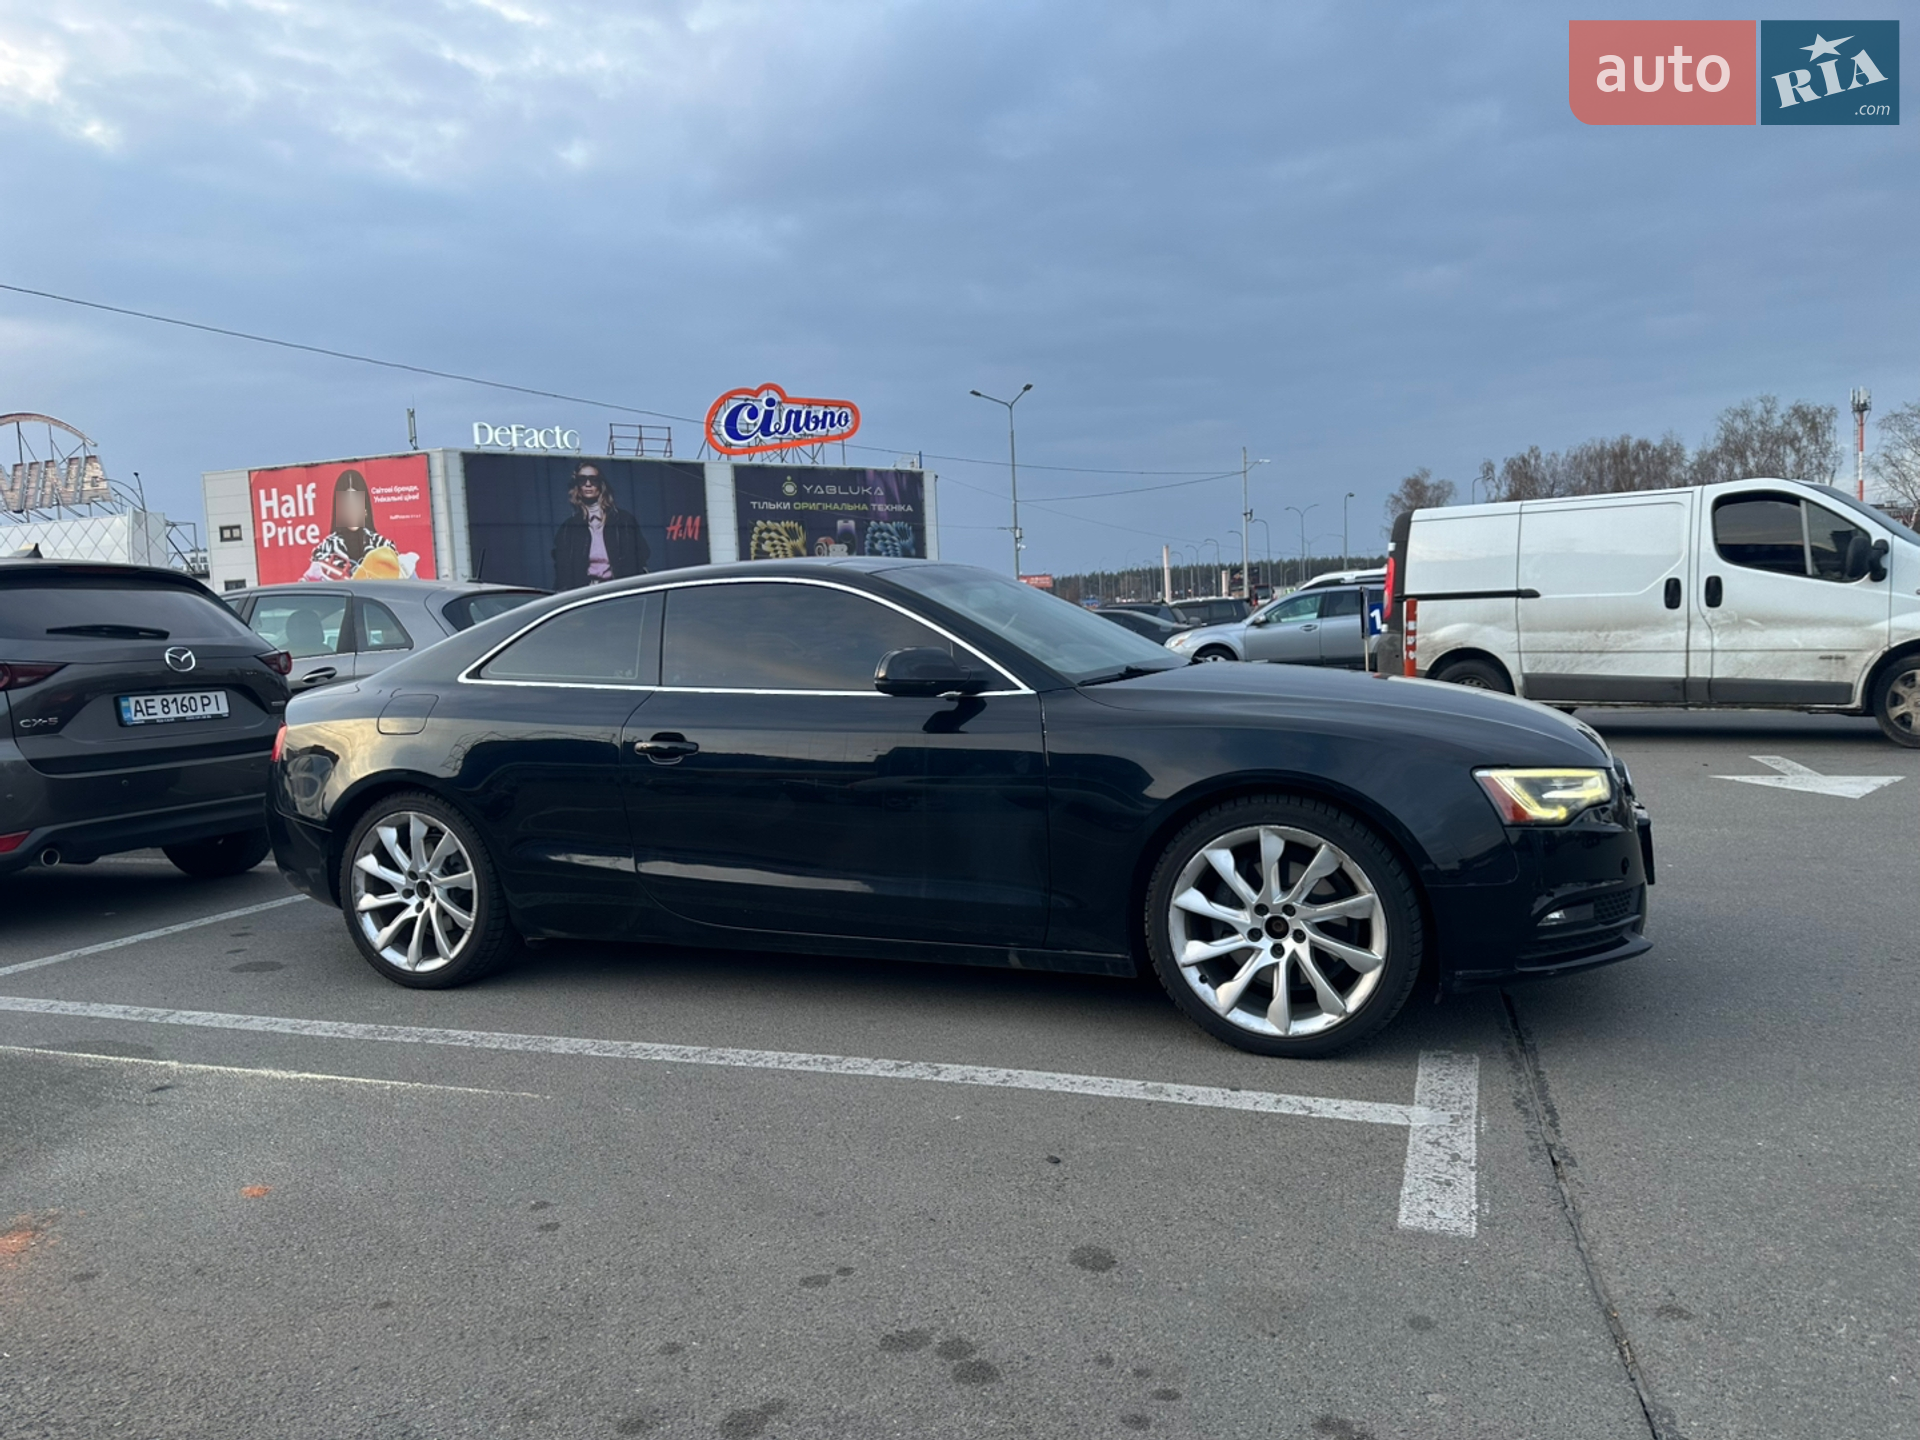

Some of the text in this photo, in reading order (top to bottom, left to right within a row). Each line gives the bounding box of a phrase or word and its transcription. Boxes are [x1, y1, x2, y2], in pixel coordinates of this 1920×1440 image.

[723, 397, 851, 443] Сільпо
[473, 422, 580, 449] DeFacto
[258, 483, 316, 519] Half
[802, 484, 884, 496] YABLUKA
[750, 501, 914, 512] ТІЛЬКИ ОРИГІНАЛЬНА ТЕХНІКА
[262, 521, 320, 548] Price
[666, 515, 701, 540] H&M
[133, 699, 158, 717] AE
[160, 696, 198, 715] 8160
[19, 717, 59, 728] CX-5
